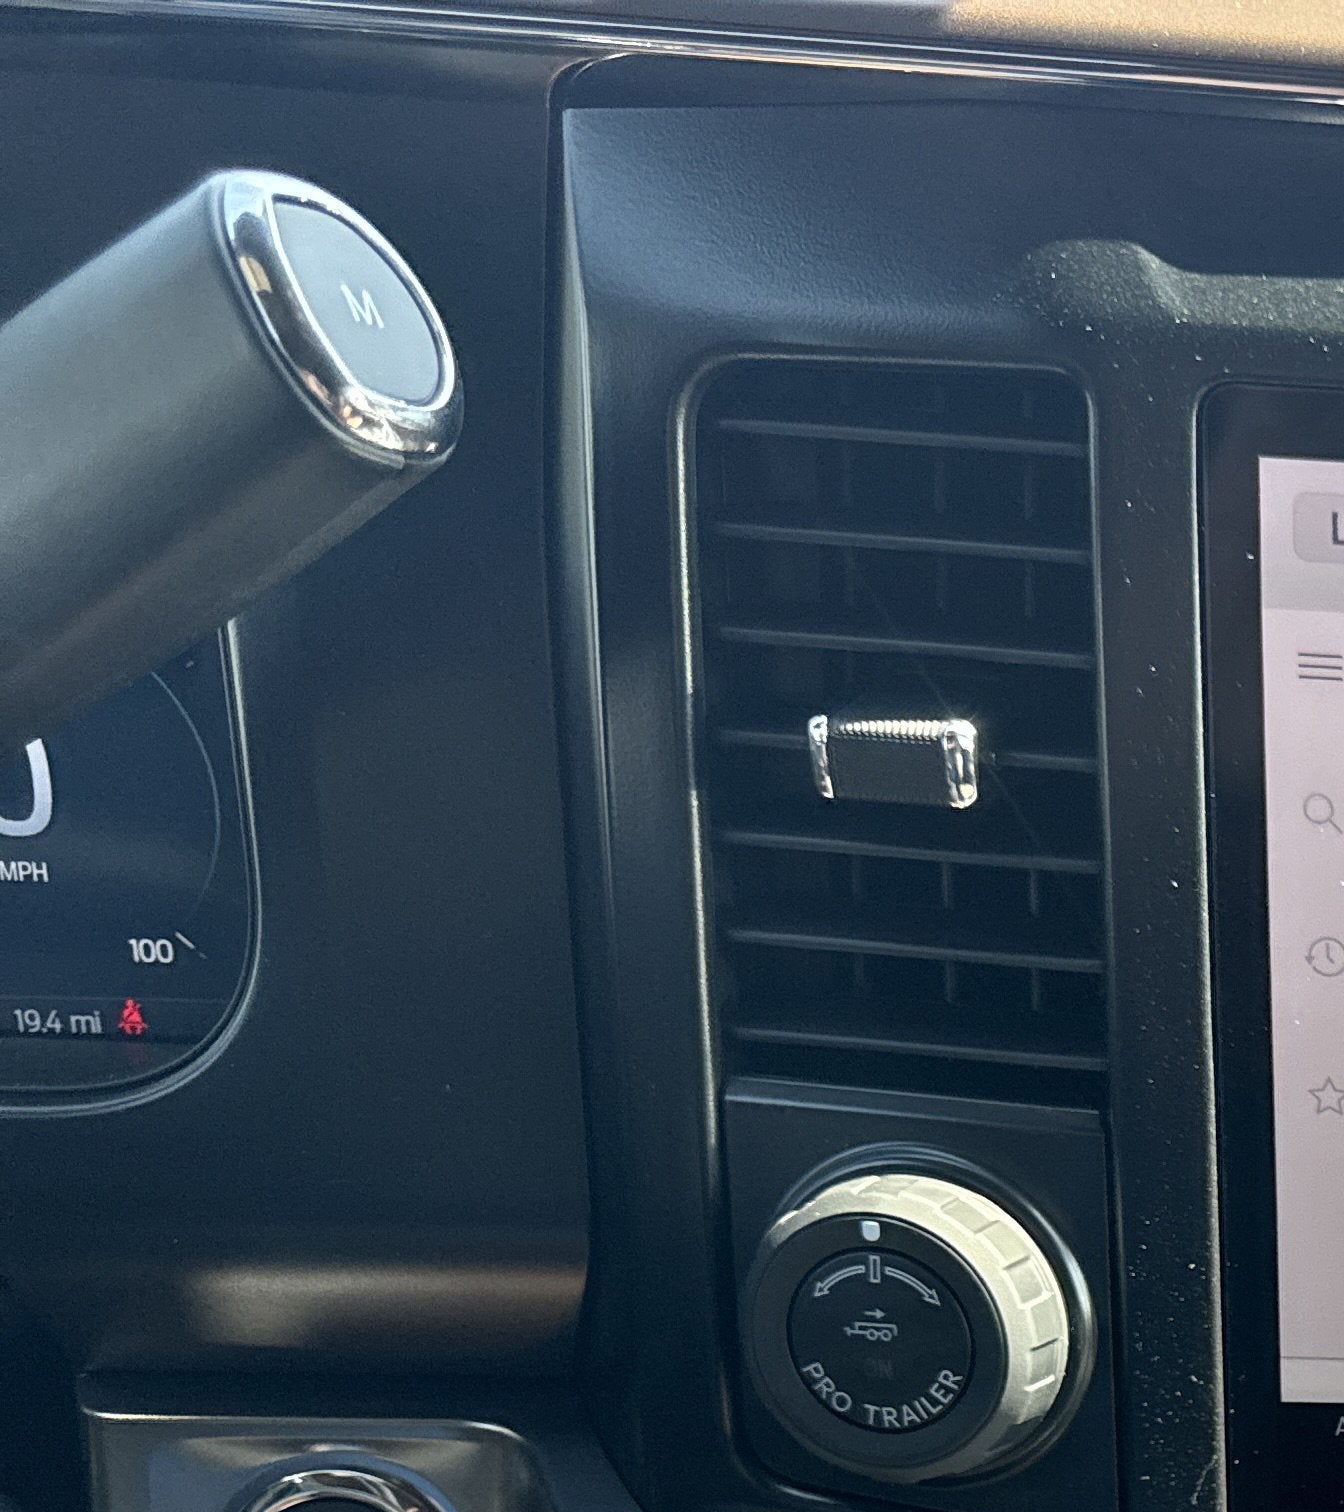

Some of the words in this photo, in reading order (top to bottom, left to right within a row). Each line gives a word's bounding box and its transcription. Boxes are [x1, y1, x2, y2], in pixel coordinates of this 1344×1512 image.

[341, 281, 385, 329] M
[0, 861, 48, 883] MPH
[129, 939, 174, 964] 100
[13, 1010, 62, 1034] 19.4
[70, 1010, 101, 1034] mi
[802, 1362, 852, 1413] PRO
[864, 1370, 964, 1428] TRAILER
